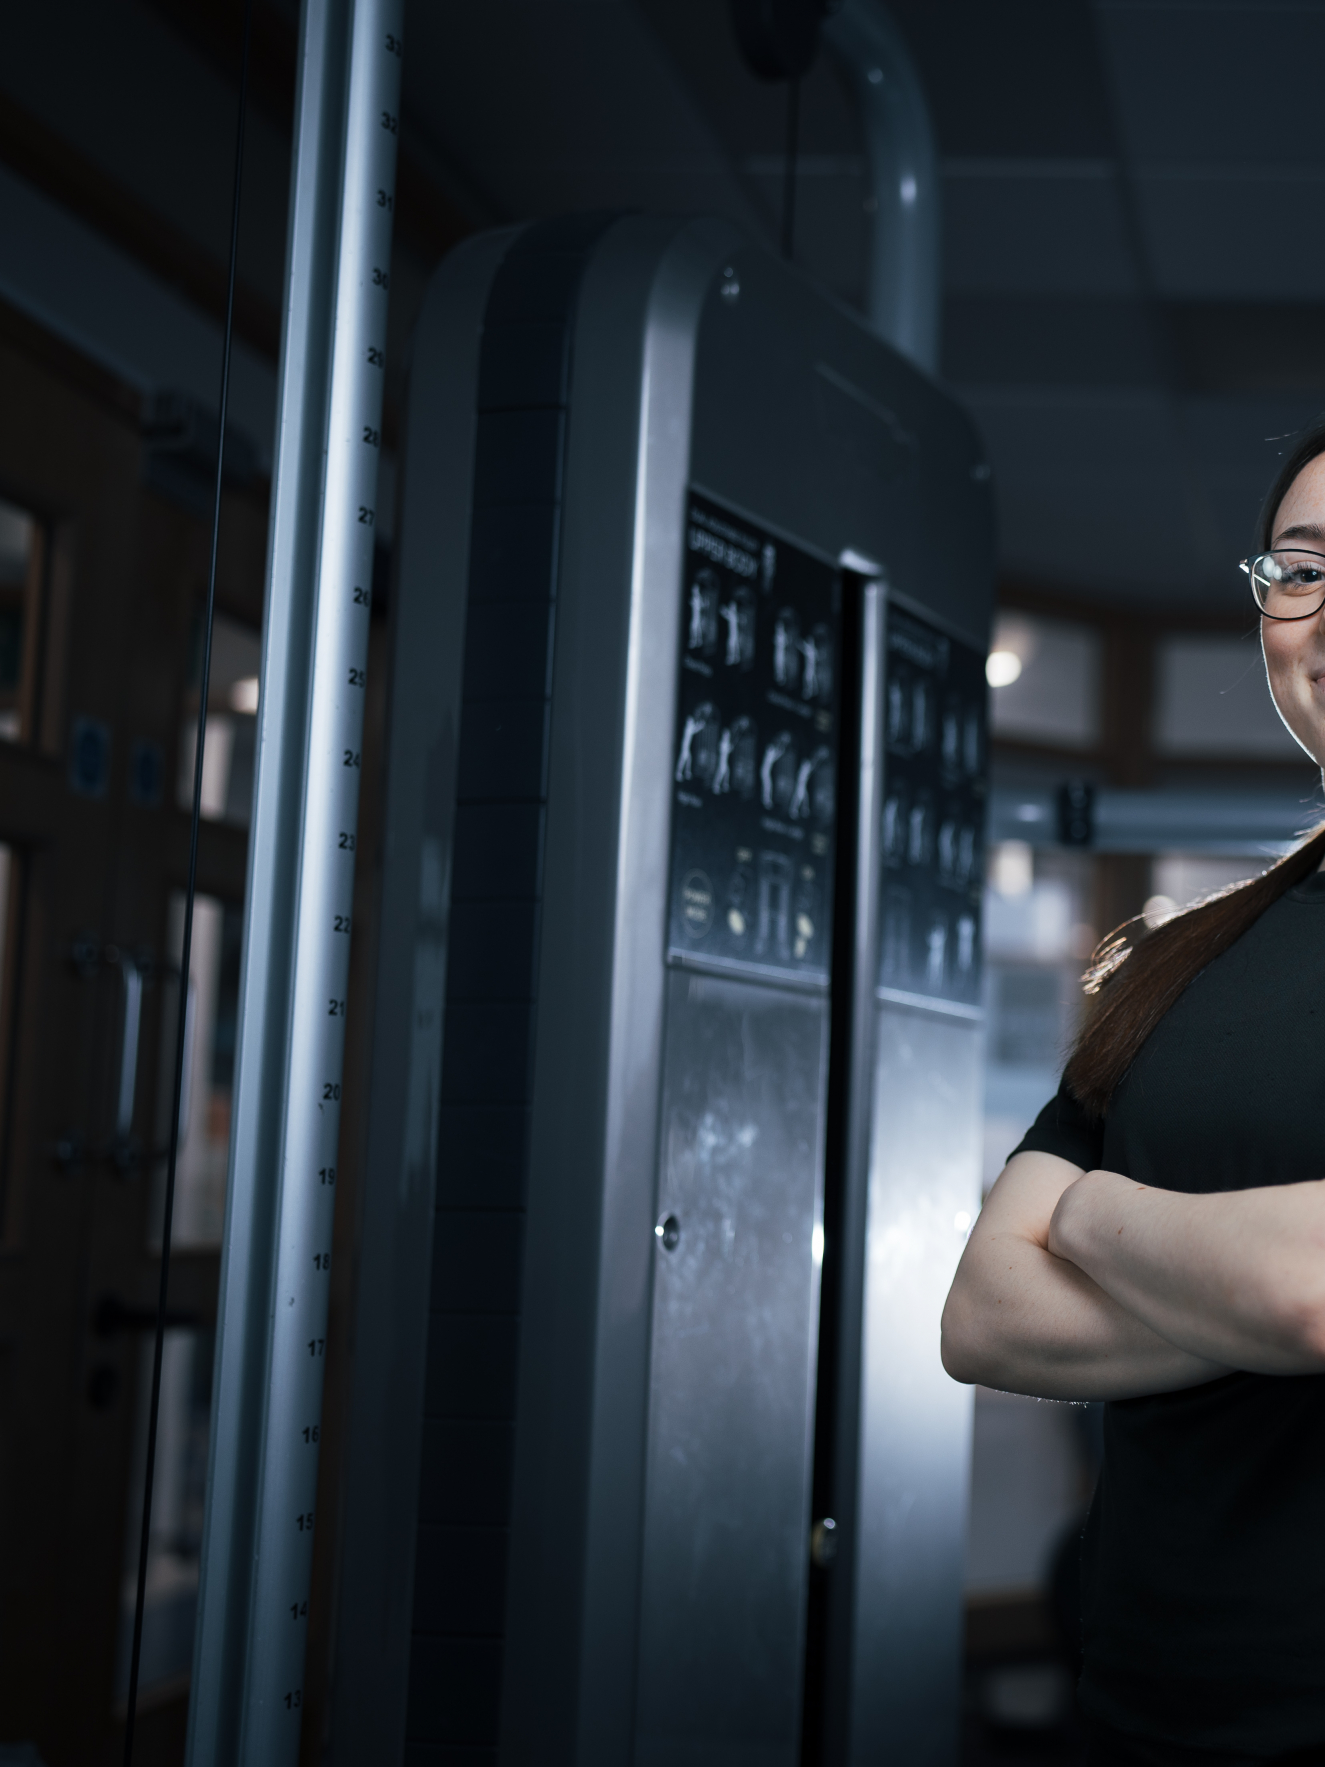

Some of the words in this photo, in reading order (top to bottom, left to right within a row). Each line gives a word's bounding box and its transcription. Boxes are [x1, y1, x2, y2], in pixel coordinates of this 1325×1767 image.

[381, 112, 397, 135] 32
[377, 190, 392, 212] 31
[368, 347, 384, 369] 29
[363, 427, 379, 447] 28
[358, 507, 374, 526] 27
[688, 526, 726, 566] UPPER
[723, 543, 758, 580] BODY
[348, 668, 366, 688] 25
[344, 750, 360, 769] 24
[338, 832, 355, 851] 23
[334, 916, 351, 933] 22
[328, 999, 345, 1017] 21
[323, 1083, 341, 1101] 20
[318, 1168, 335, 1186] 19
[313, 1253, 330, 1271] 18
[308, 1339, 325, 1357] 17
[302, 1425, 320, 1444] 16
[297, 1512, 314, 1531] 15
[290, 1601, 308, 1620] 14
[284, 1689, 301, 1710] 13
